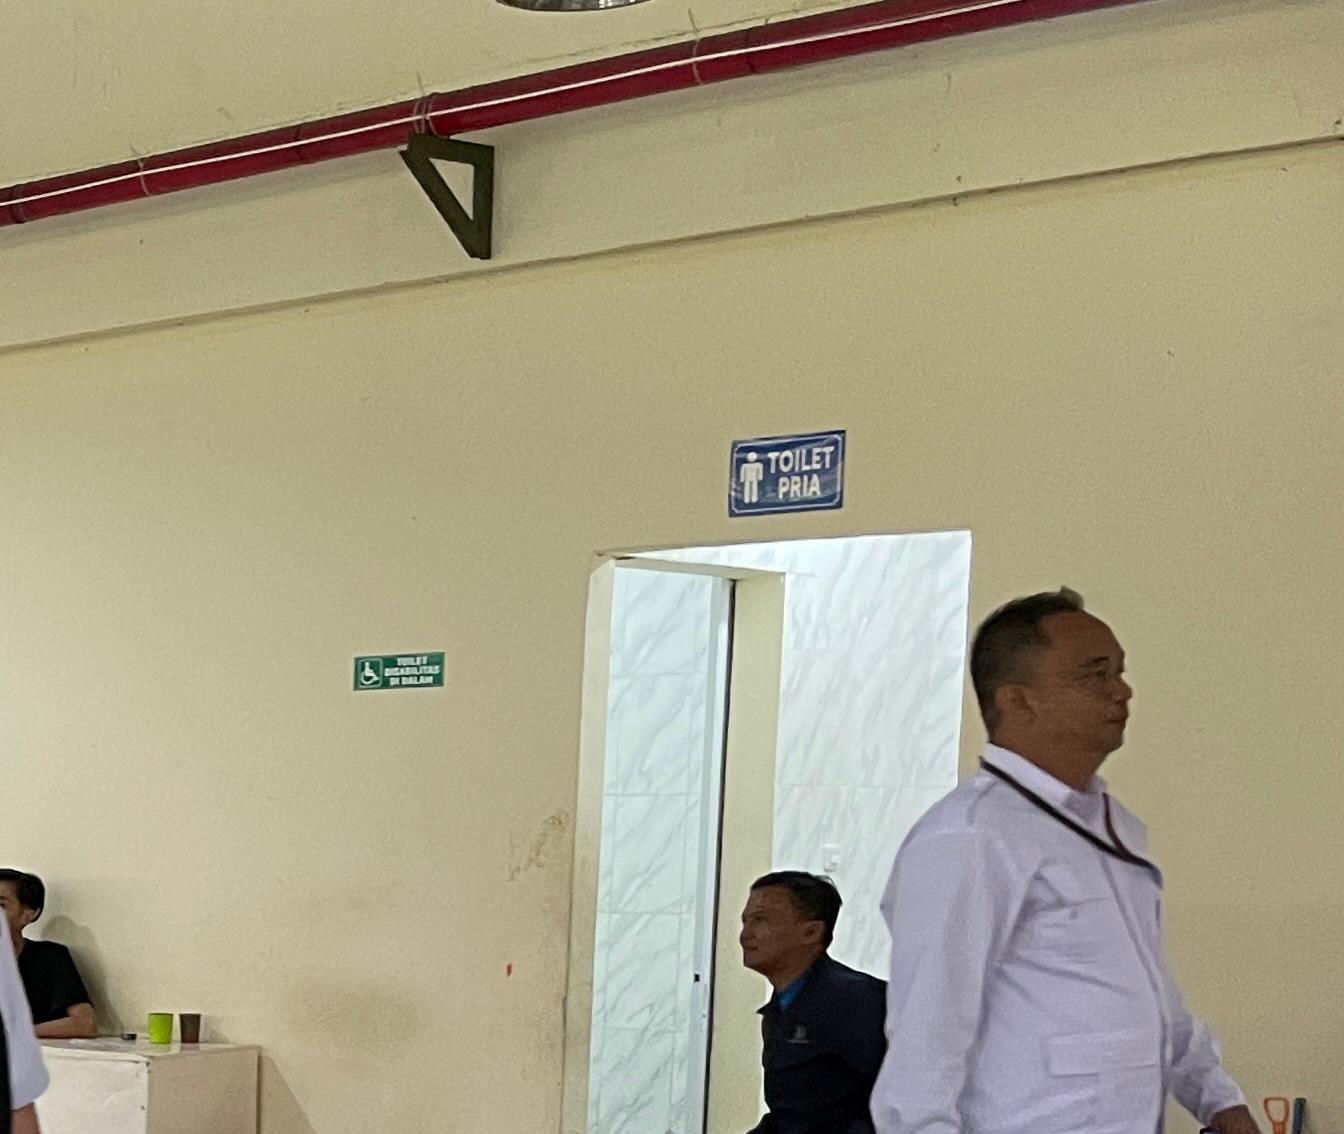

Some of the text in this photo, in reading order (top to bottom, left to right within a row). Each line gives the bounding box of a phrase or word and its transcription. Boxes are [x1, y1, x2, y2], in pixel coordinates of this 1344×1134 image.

[768, 446, 834, 473] TOILET
[778, 474, 820, 499] PRIA
[397, 656, 428, 666] TOILET
[390, 676, 433, 686] DI DALAM
